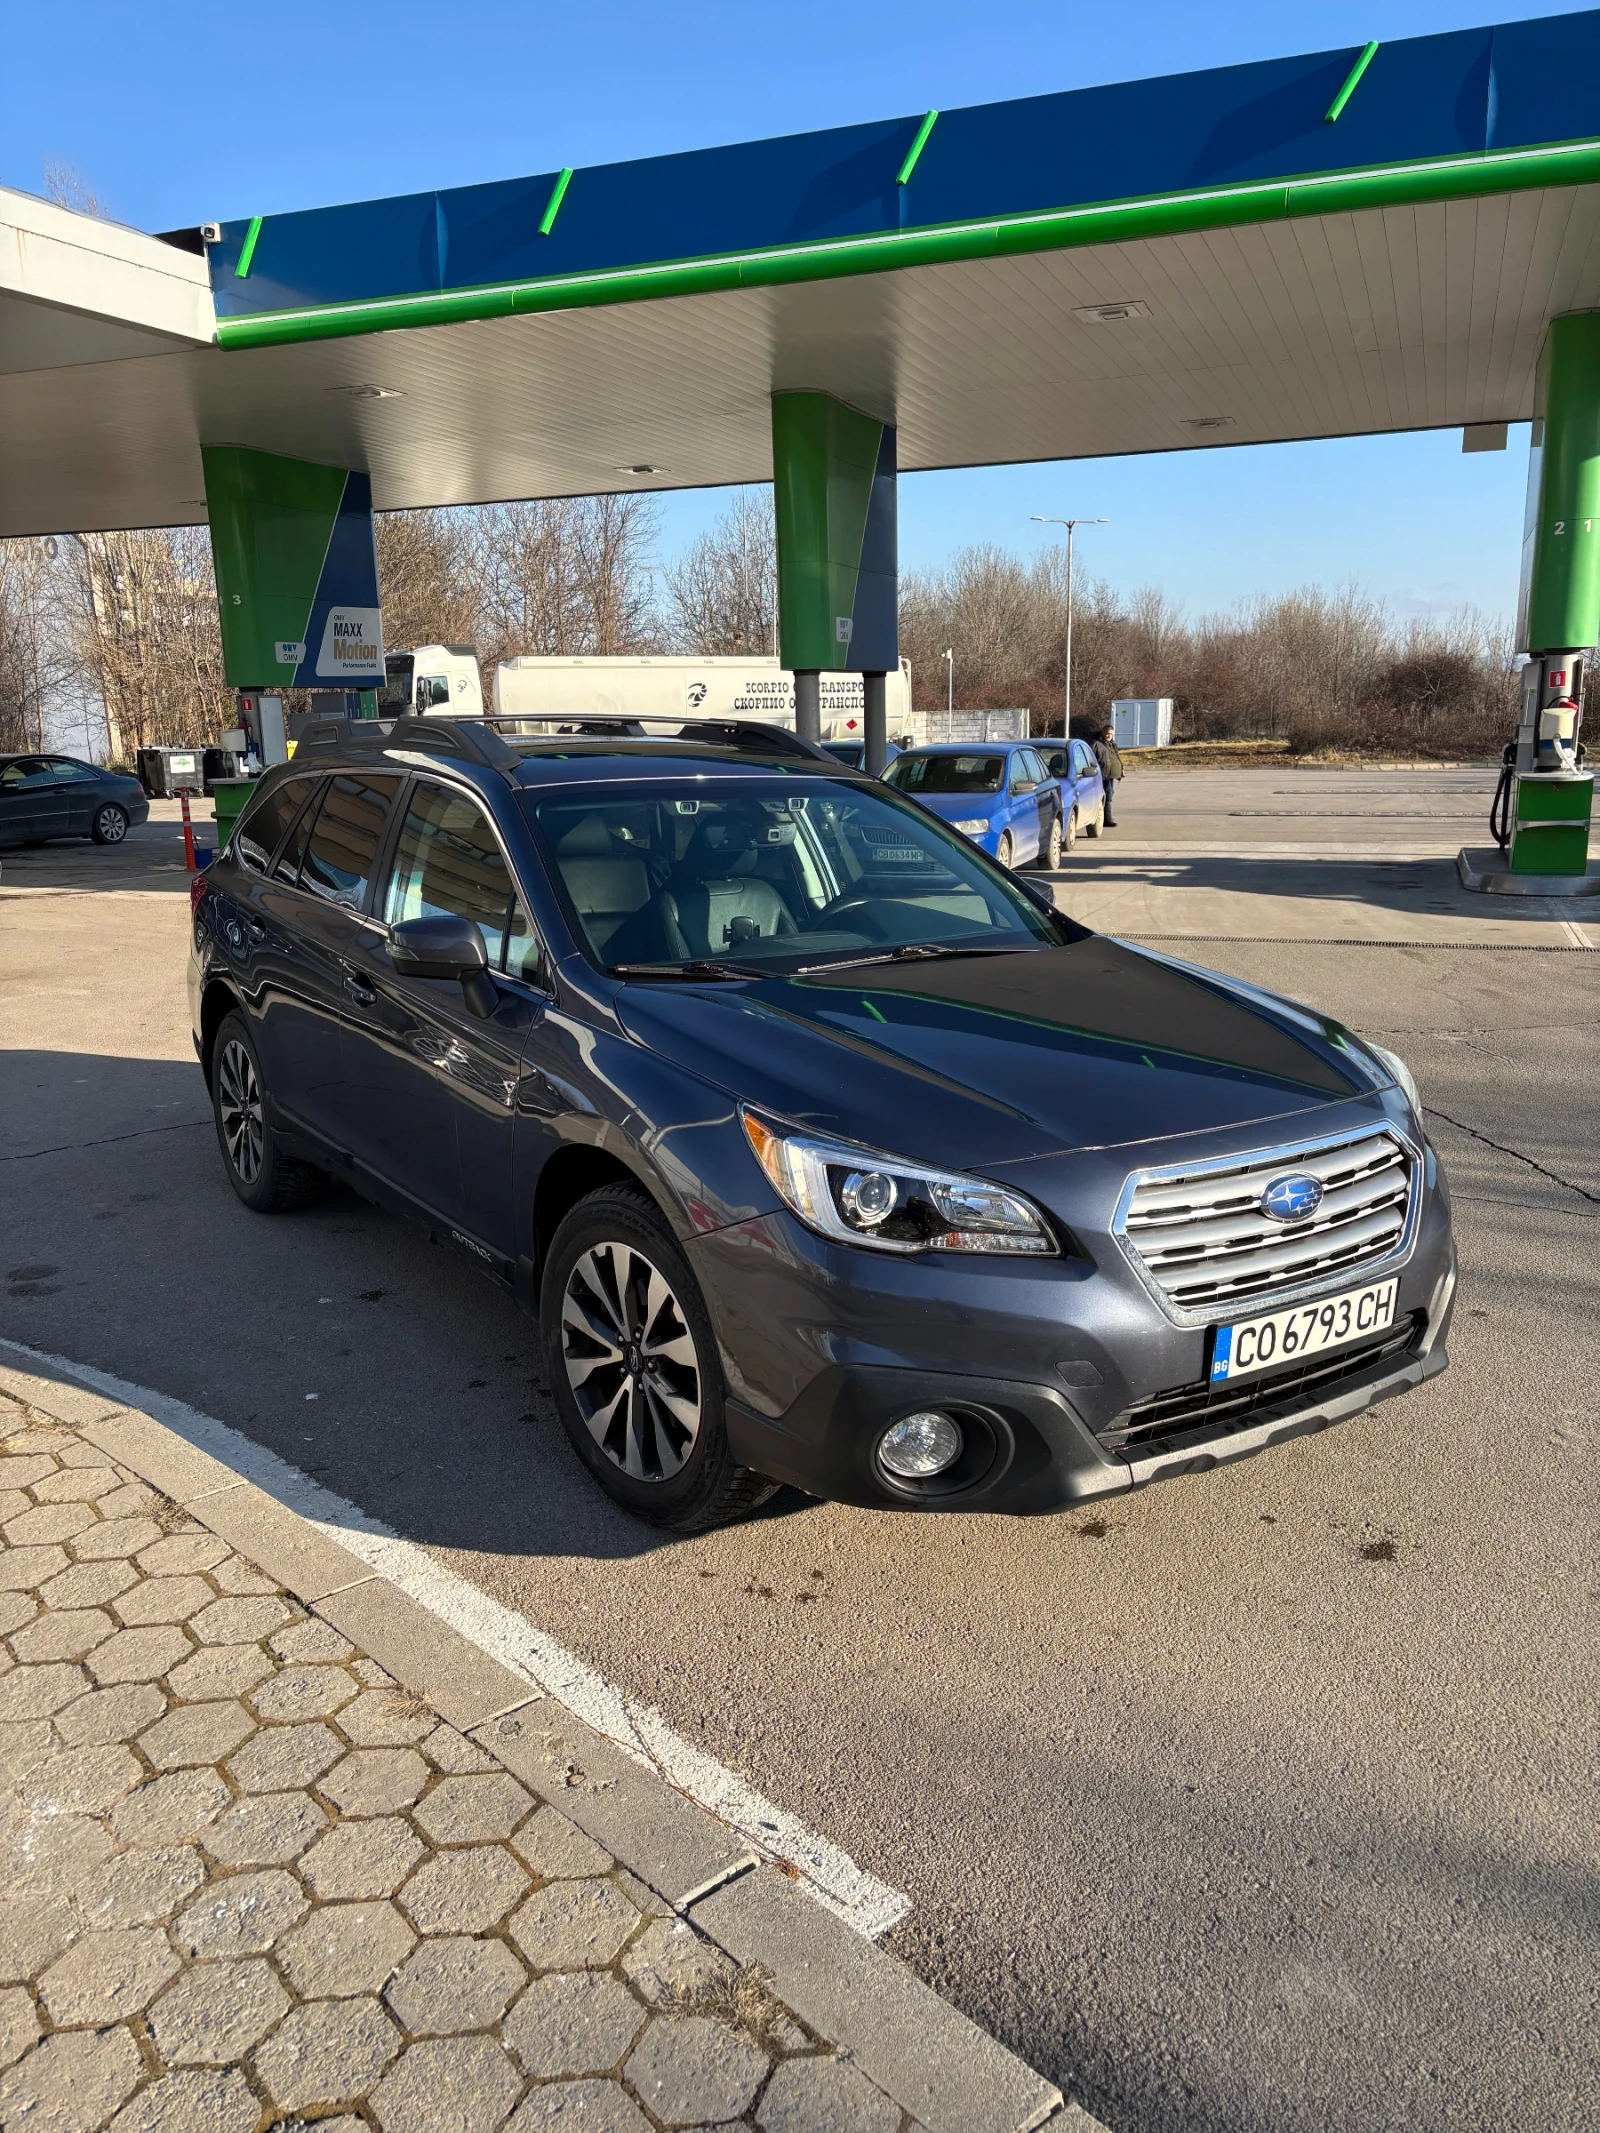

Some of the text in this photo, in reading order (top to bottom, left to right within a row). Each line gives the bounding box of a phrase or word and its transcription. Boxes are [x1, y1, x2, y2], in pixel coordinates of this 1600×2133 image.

[1554, 519, 1592, 535] 2 1
[232, 594, 242, 605] 3
[333, 622, 363, 637] MAXX
[333, 638, 378, 660] Motion
[283, 653, 298, 661] OMV
[745, 682, 789, 694] SCORPIO
[819, 682, 864, 693] RANSPO
[734, 697, 785, 710] СКОРПИО
[819, 697, 864, 709] РАНСПО
[1214, 1360, 1228, 1375] BG
[1282, 1299, 1351, 1354] 6793
[1356, 1284, 1393, 1331] CH
